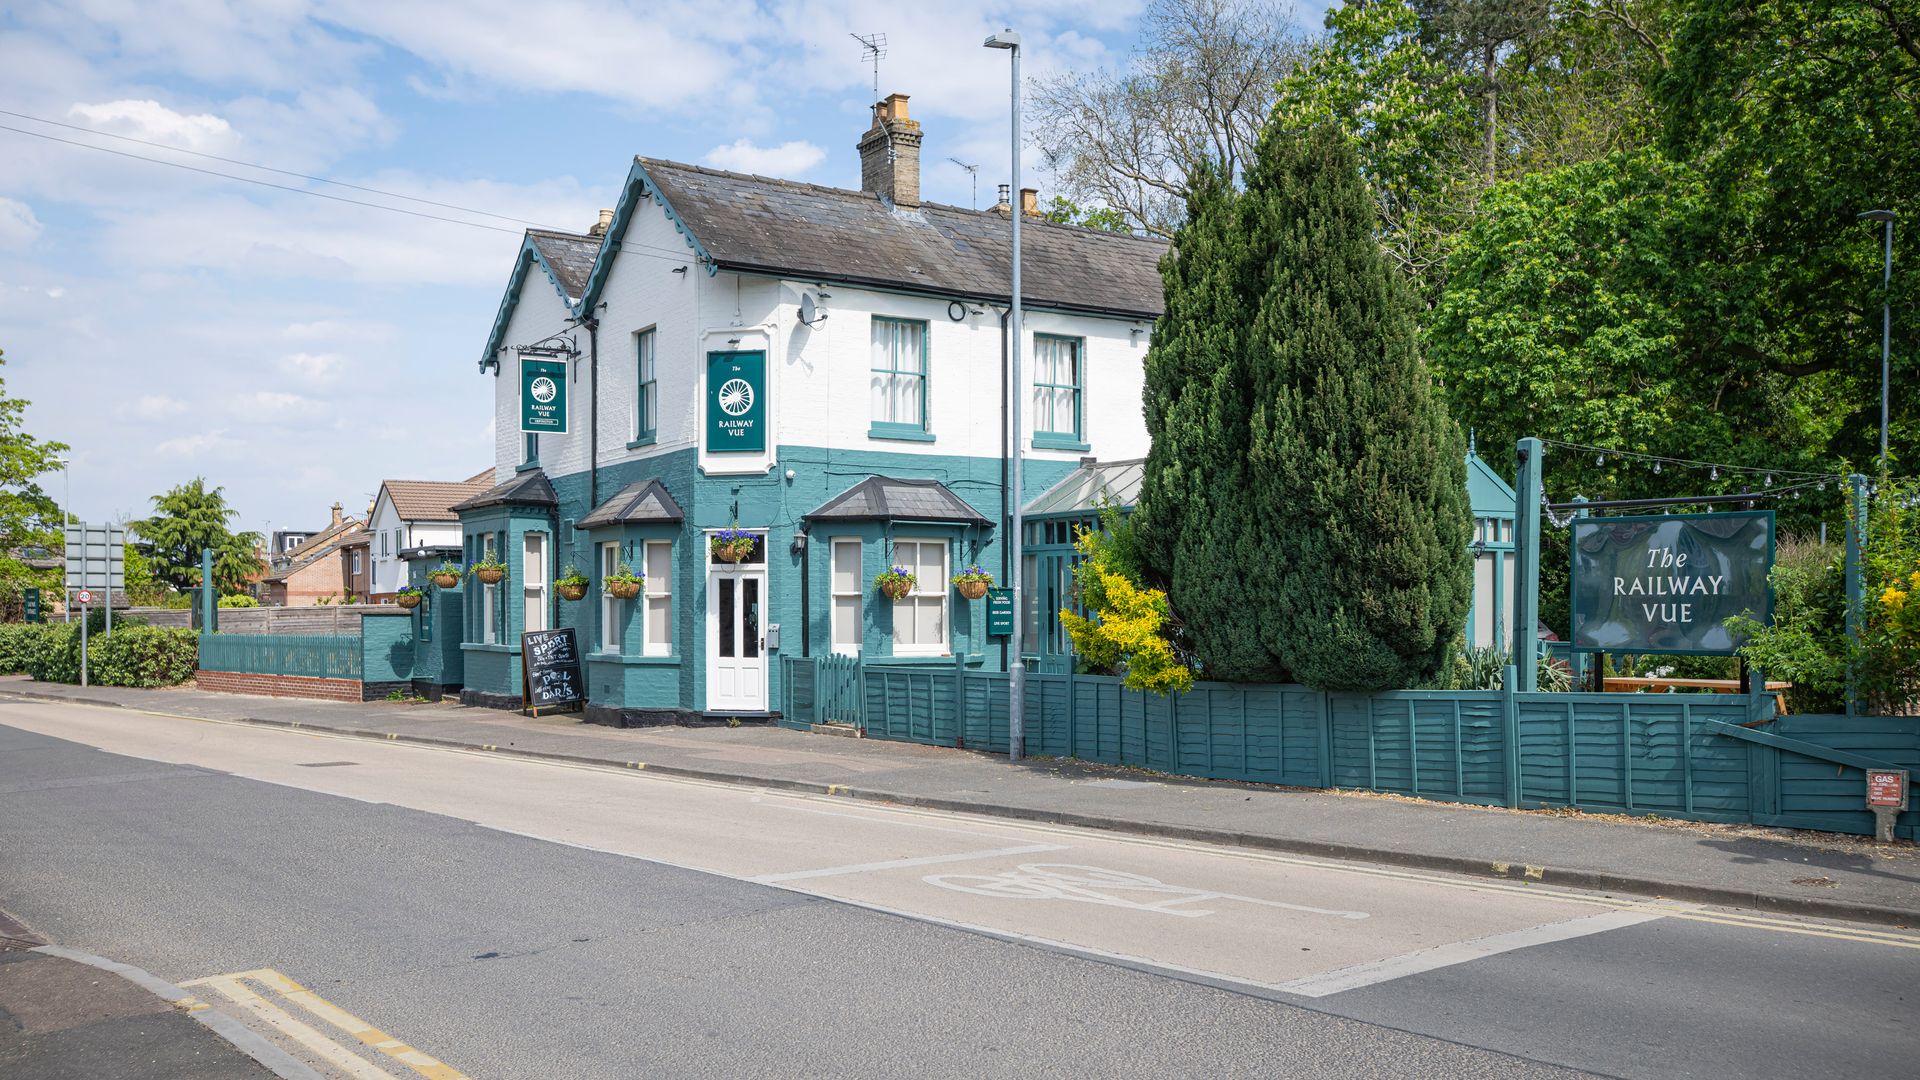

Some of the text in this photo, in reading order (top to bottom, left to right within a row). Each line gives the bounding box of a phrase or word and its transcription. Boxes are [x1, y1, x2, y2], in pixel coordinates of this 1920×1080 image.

[718, 419, 754, 428] RAILWAY
[728, 428, 745, 437] VUE
[1647, 547, 1687, 568] The
[1613, 575, 1724, 596] RAILWAY
[1642, 603, 1693, 623] VUE
[527, 633, 549, 645] LIVE
[533, 634, 568, 656] SPORT
[1875, 775, 1894, 783] GAS
